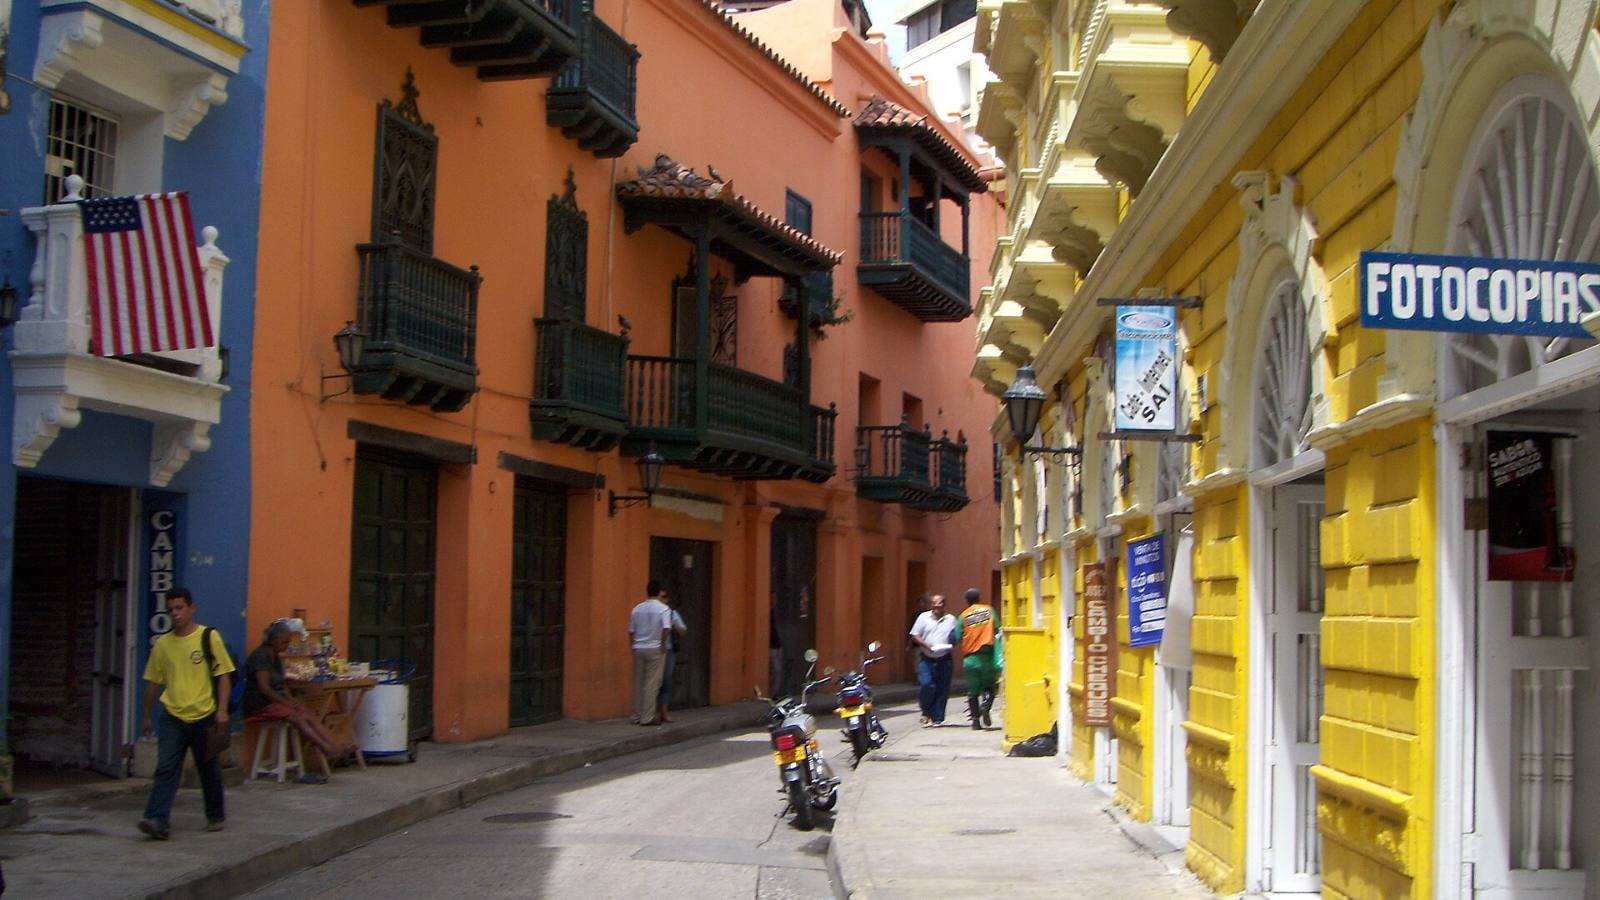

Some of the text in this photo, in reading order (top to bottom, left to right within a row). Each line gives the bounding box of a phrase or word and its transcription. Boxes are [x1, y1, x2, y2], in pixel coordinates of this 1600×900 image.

[1367, 262, 1600, 324] FOTOCOPIAS
[1142, 384, 1170, 423] SAI
[1087, 600, 1108, 653] CAMBIO
